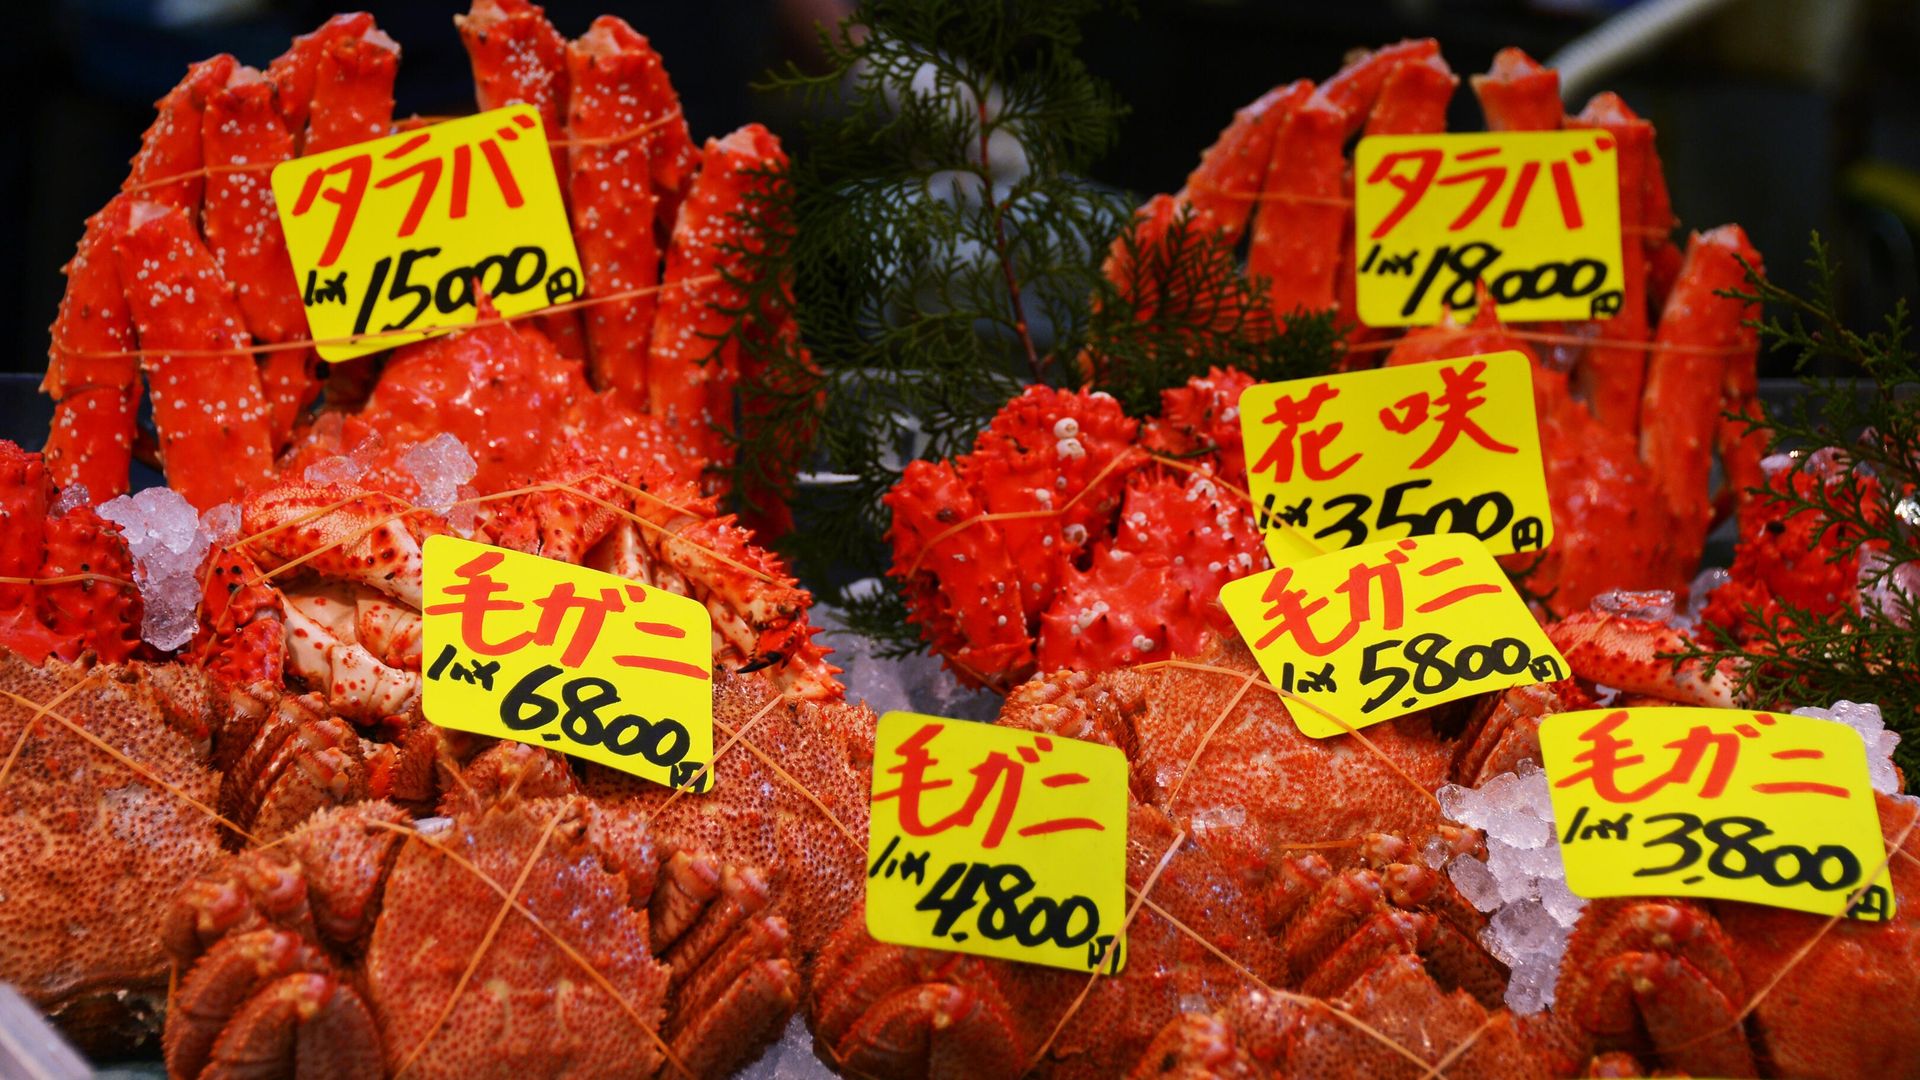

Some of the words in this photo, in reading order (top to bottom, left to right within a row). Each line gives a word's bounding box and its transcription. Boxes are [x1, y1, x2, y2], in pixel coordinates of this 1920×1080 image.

[291, 114, 536, 267] タラバ
[1366, 136, 1616, 240] タラバ
[1251, 361, 1519, 483] 花咲
[424, 551, 710, 680] 毛ガニ
[1255, 539, 1502, 657] 毛ガニ
[872, 724, 1105, 849] 毛ガニ
[1554, 710, 1851, 803] 毛ガニ
